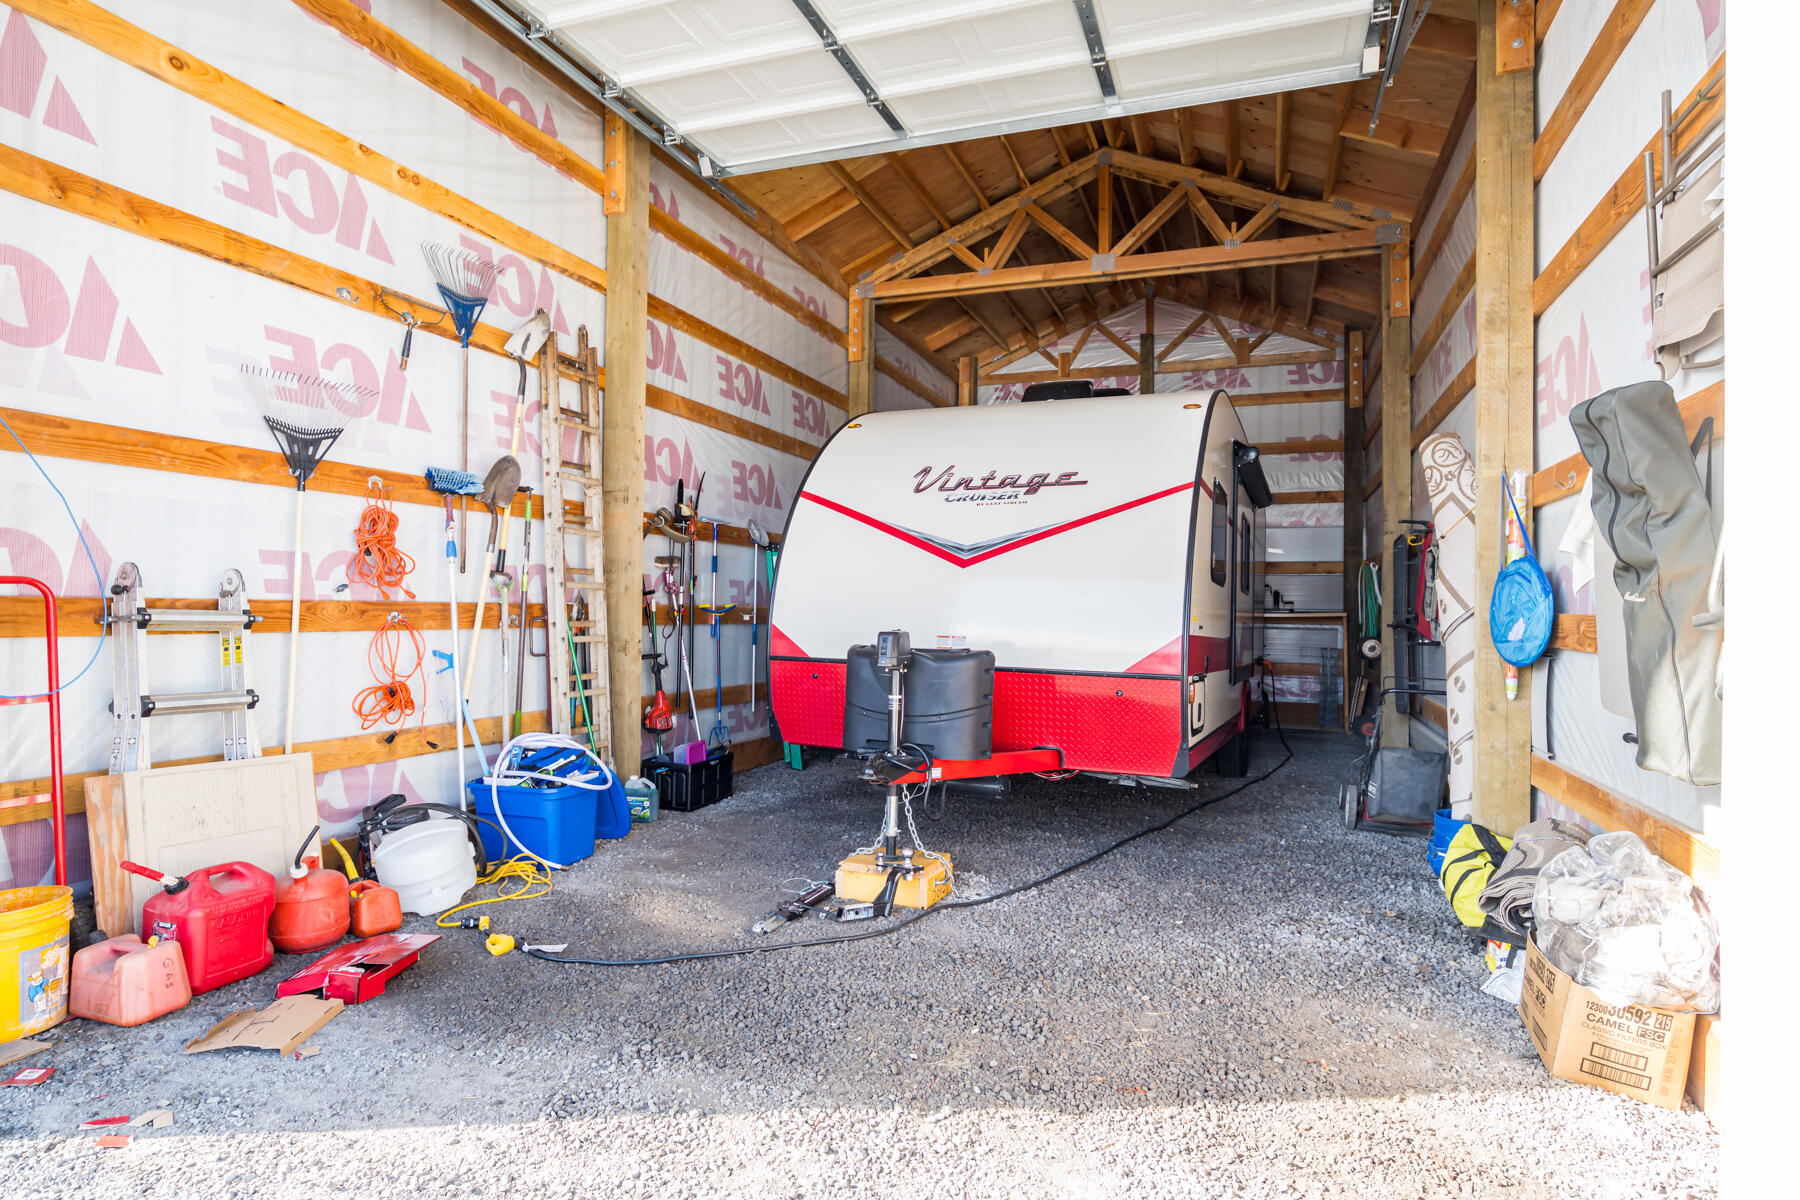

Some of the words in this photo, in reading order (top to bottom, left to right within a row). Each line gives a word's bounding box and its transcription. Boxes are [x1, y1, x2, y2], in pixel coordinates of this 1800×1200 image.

[913, 464, 1088, 496] Vintage
[943, 490, 1022, 504] CRUISER
[1581, 1021, 1616, 1037] CLASSIC
[1649, 1040, 1666, 1051] BOX
[1586, 1013, 1633, 1034] CAMEL
[1637, 1027, 1665, 1043] FSC
